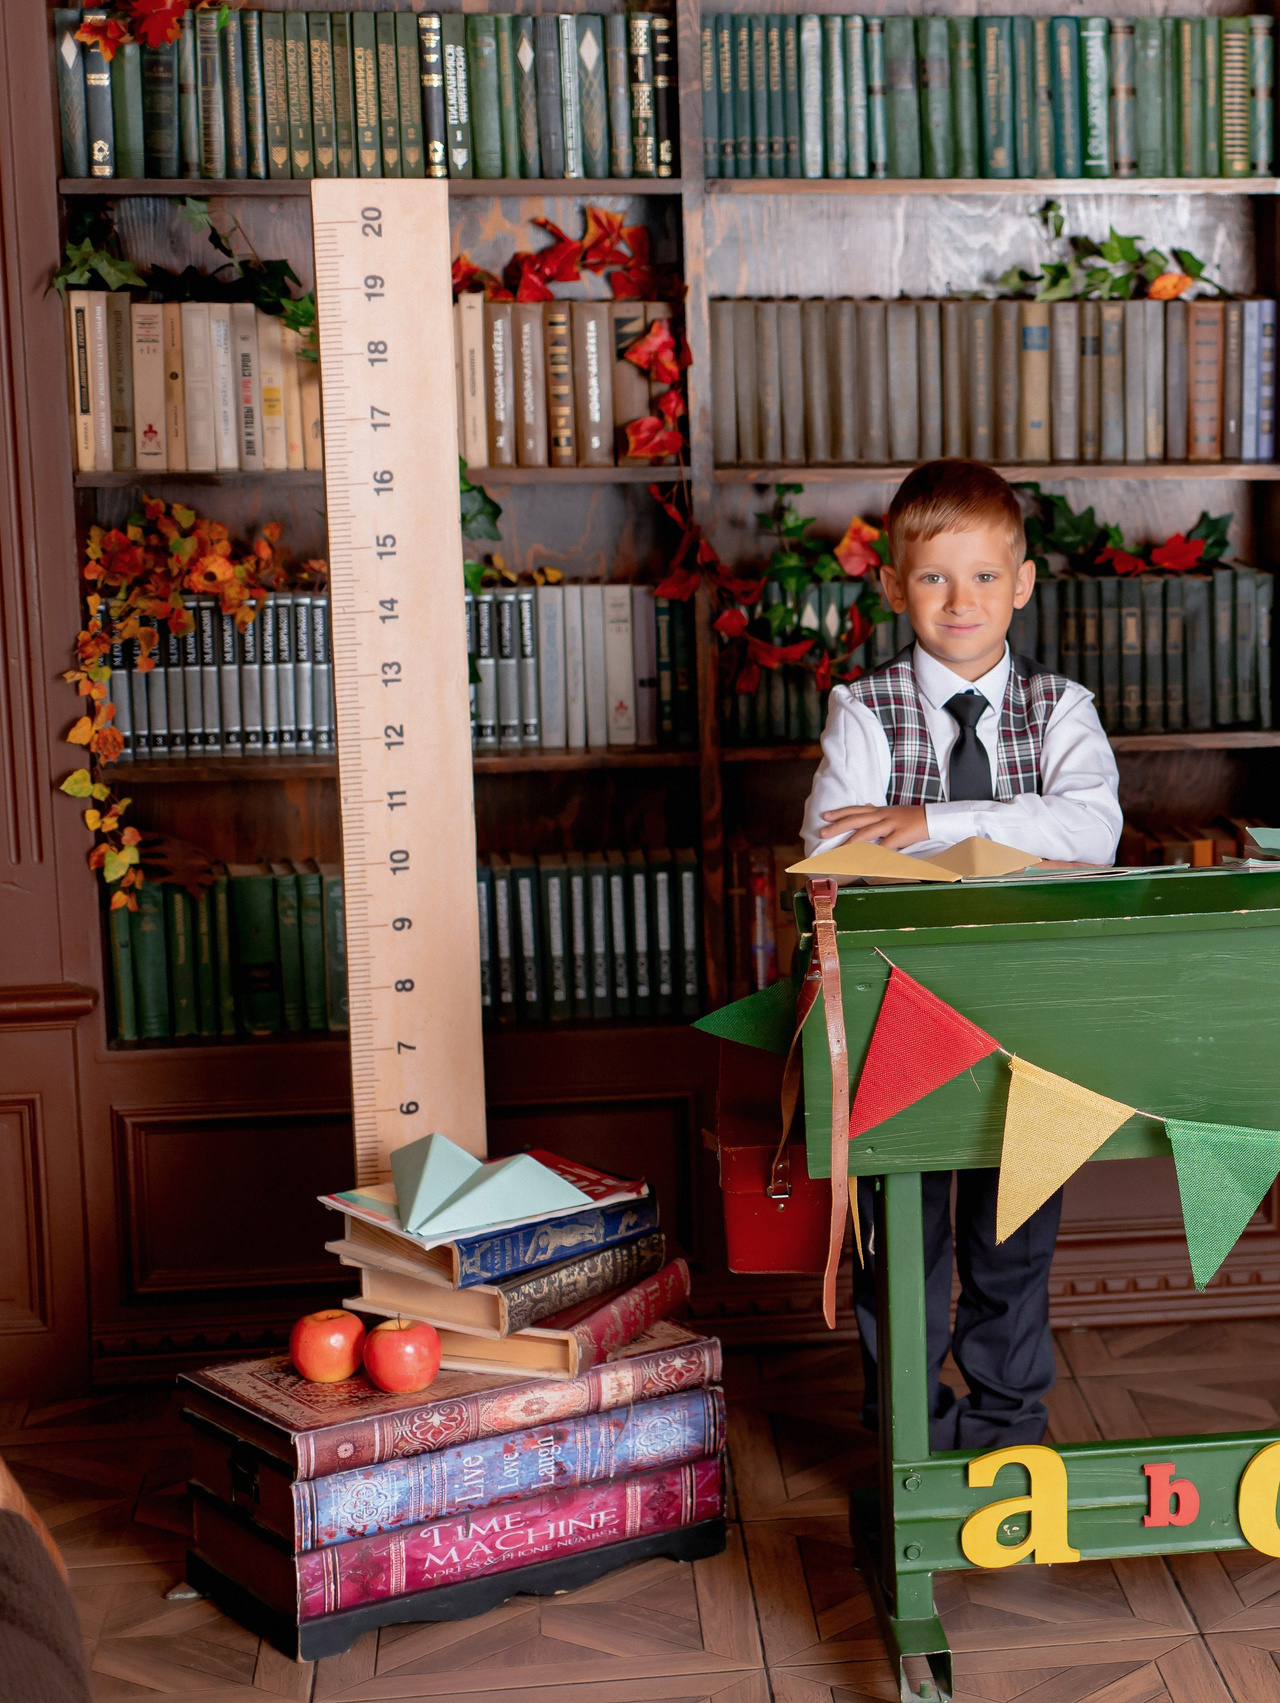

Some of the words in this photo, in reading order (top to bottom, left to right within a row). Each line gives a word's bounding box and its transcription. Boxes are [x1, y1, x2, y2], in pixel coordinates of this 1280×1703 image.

[361, 206, 382, 238] 20
[364, 275, 385, 302] 19
[367, 340, 388, 367] 18
[370, 405, 391, 432] 17
[373, 470, 394, 496] 16
[376, 534, 397, 560] 15
[378, 597, 399, 624] 14
[381, 661, 402, 688] 13
[384, 724, 405, 751] 12
[387, 790, 407, 812] 11
[389, 849, 410, 876] 10
[391, 917, 413, 932] 9
[394, 978, 416, 993] 8
[396, 1040, 417, 1055] 7
[398, 1100, 420, 1116] 6
[497, 1452, 519, 1490] Love
[530, 1434, 562, 1490] Laugh
[454, 1454, 484, 1504] Live
[961, 1443, 1081, 1569] a
[1142, 1462, 1201, 1528] b
[419, 1511, 524, 1548] TIME
[422, 1508, 618, 1571] MACHINE
[421, 1562, 480, 1582] ADRESS
[501, 1543, 553, 1563] PHONE
[556, 1527, 620, 1549] NUMBER
